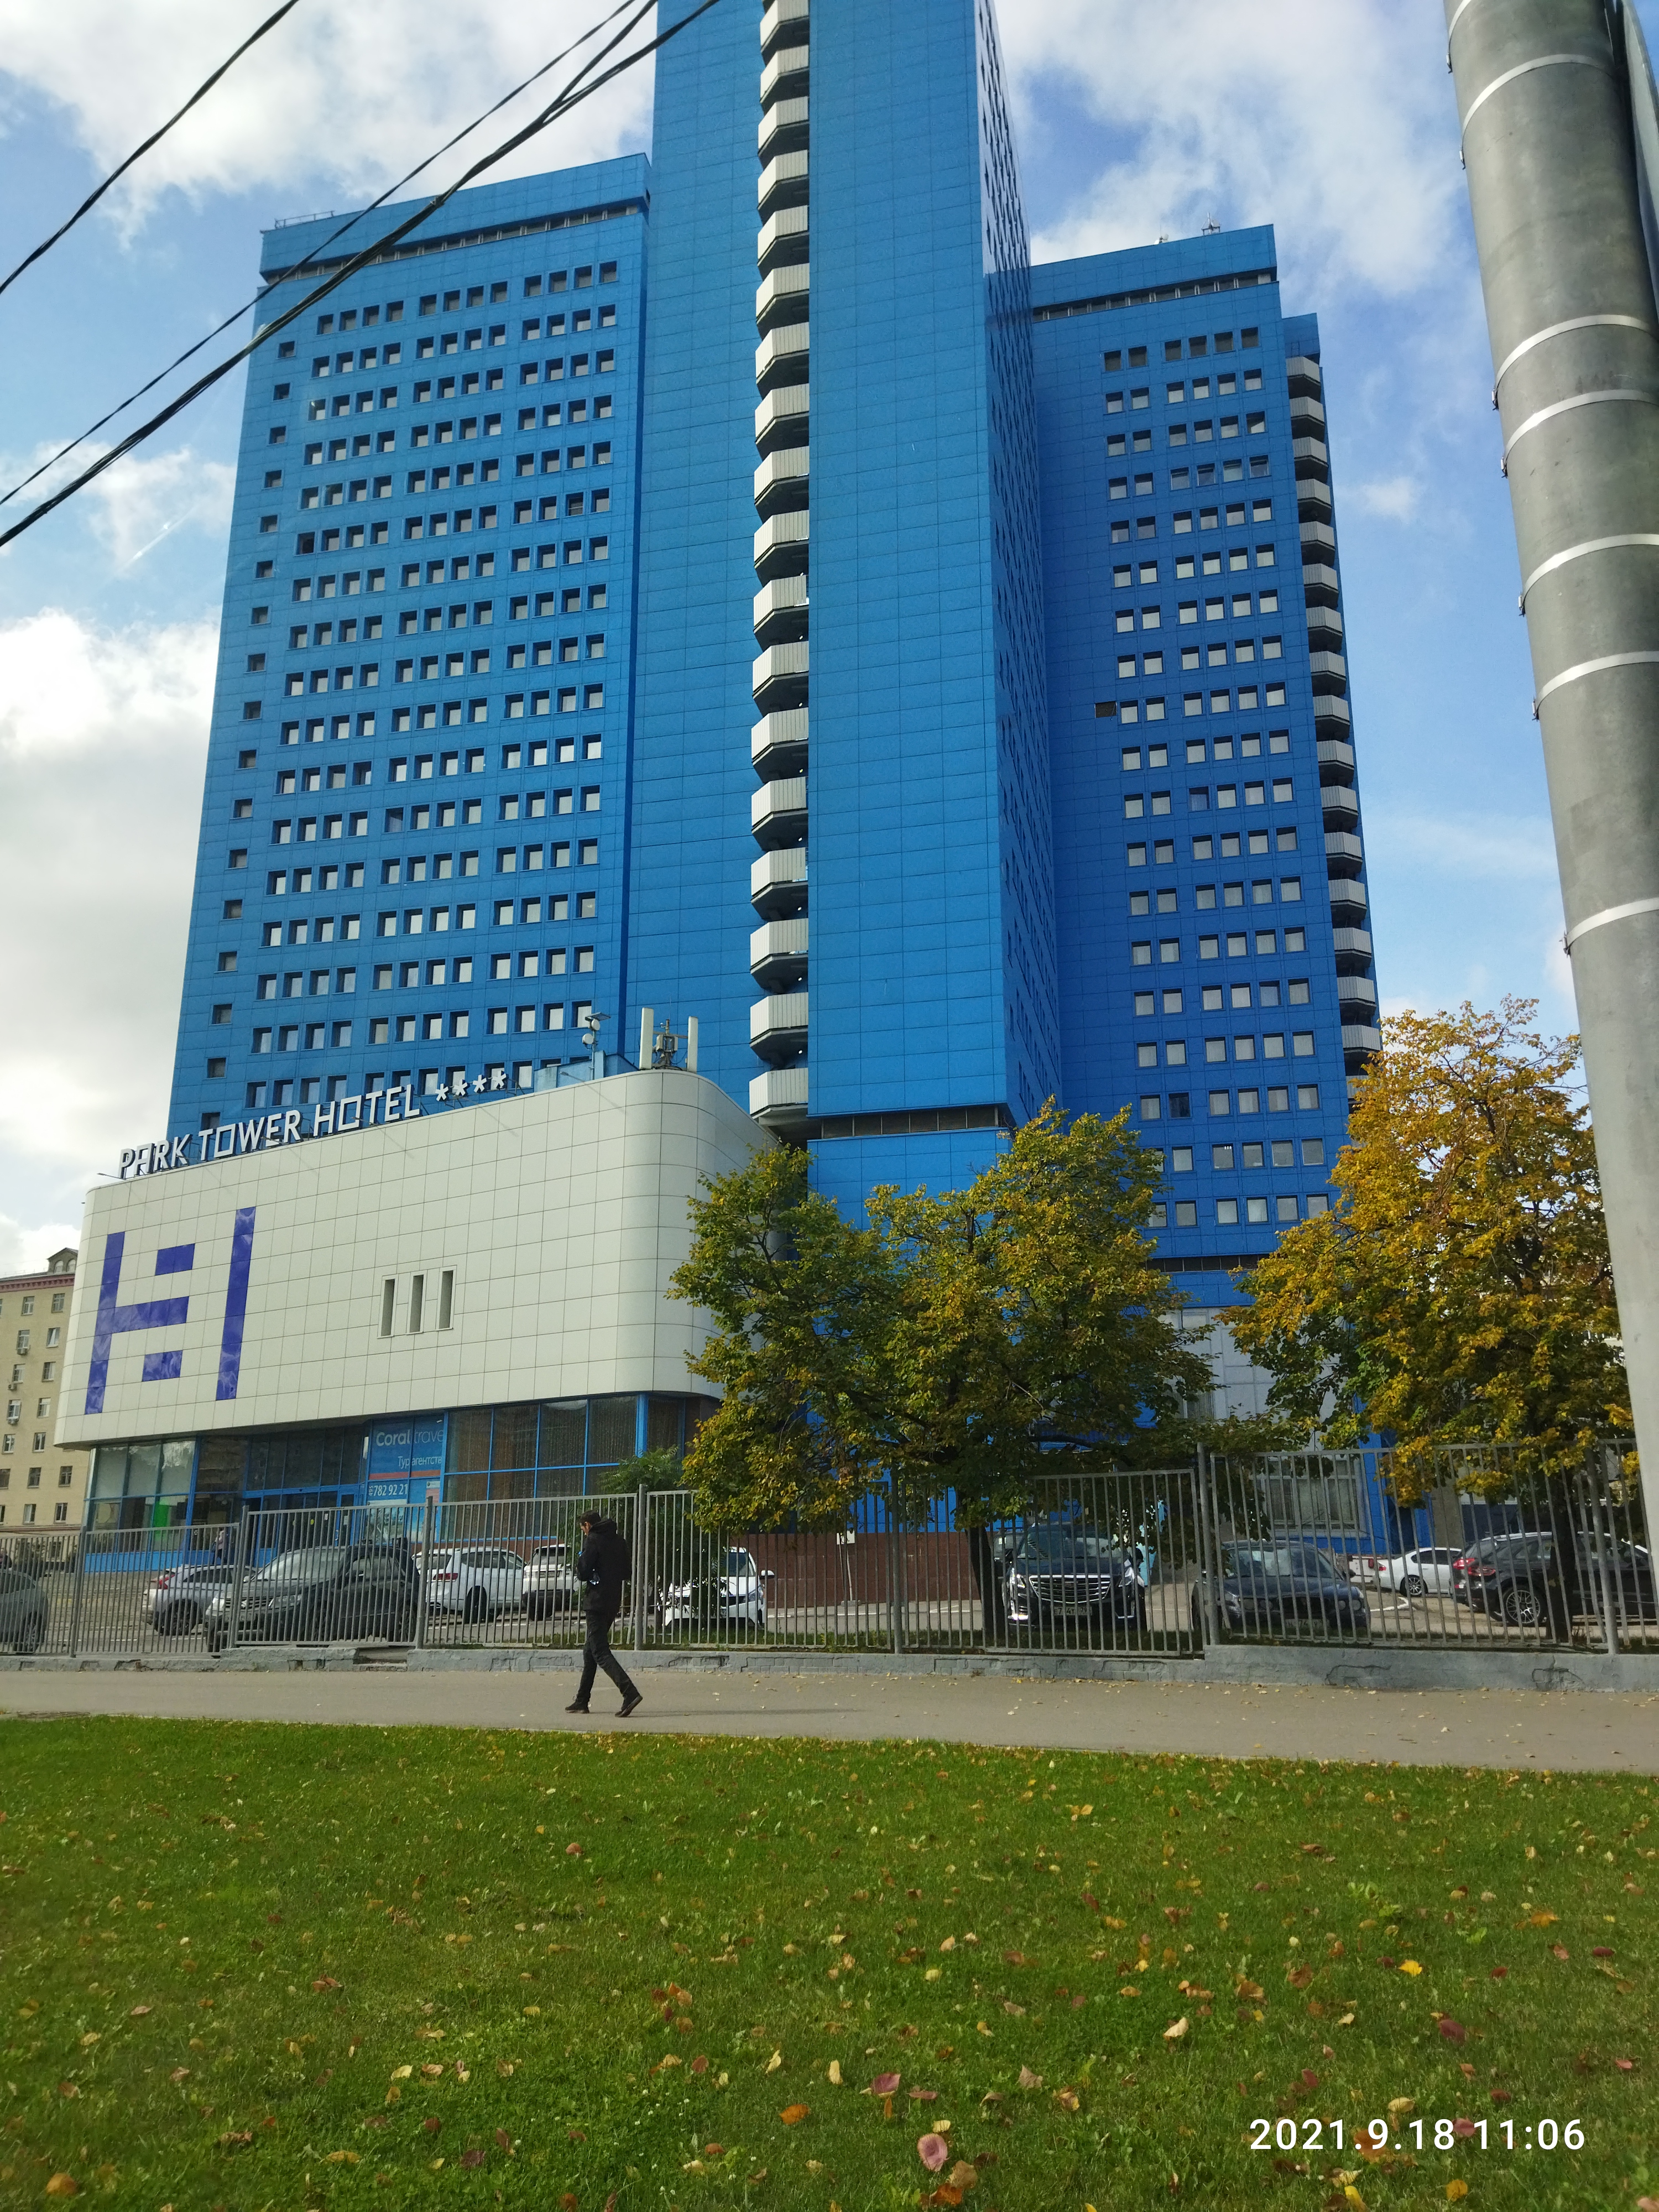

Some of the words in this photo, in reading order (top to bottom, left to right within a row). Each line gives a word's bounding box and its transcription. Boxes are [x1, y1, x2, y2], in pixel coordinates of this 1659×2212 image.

[118, 1133, 193, 1178] PARK
[198, 1107, 302, 1161] TOWER
[313, 1084, 420, 1136] HOTEL
[376, 1430, 410, 1447] Coral
[414, 1430, 444, 1444] trave
[398, 1456, 442, 1469] Турагентств
[373, 1485, 387, 1496] 782
[388, 1484, 397, 1496] 92
[399, 1484, 408, 1495] 21
